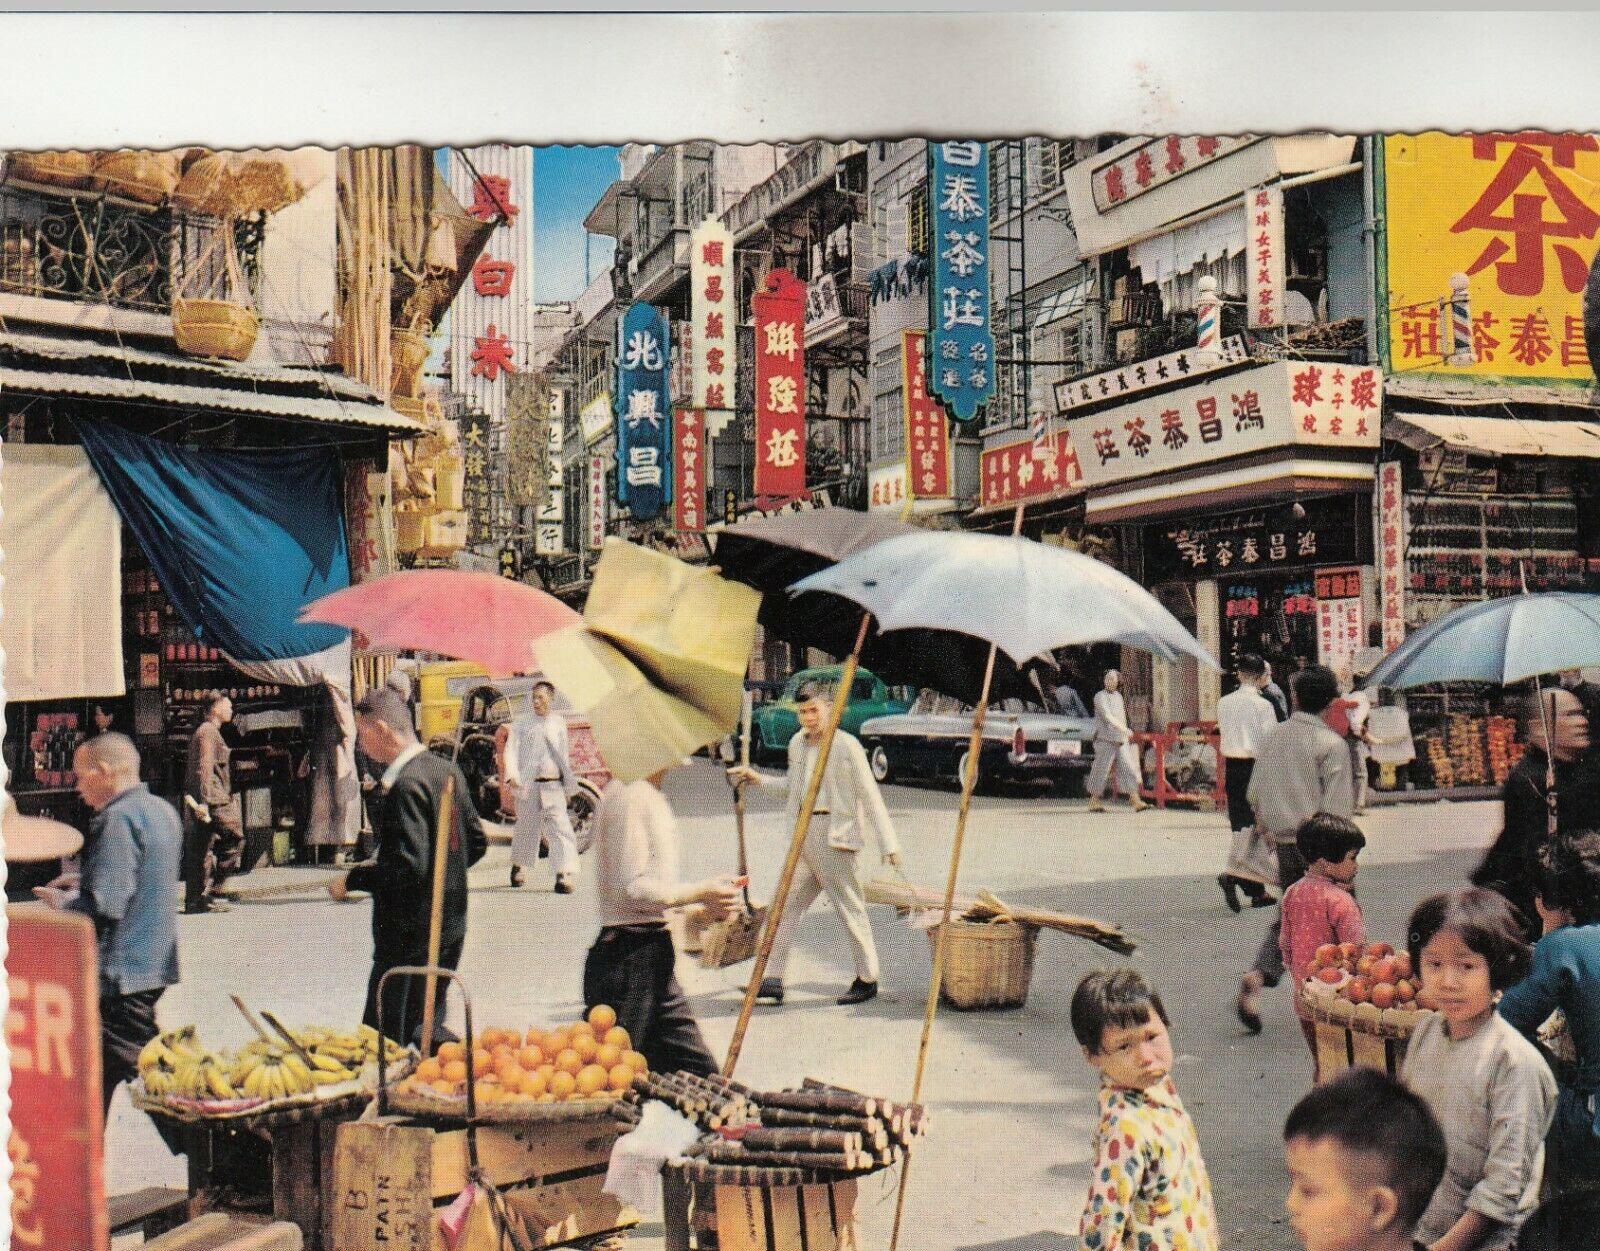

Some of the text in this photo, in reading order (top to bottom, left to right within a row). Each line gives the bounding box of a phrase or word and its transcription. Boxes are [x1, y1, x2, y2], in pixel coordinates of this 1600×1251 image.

[1449, 132, 1600, 297] 茶
[623, 332, 663, 487] 兆興昌
[1092, 388, 1265, 466] 鴻昌泰茶莊
